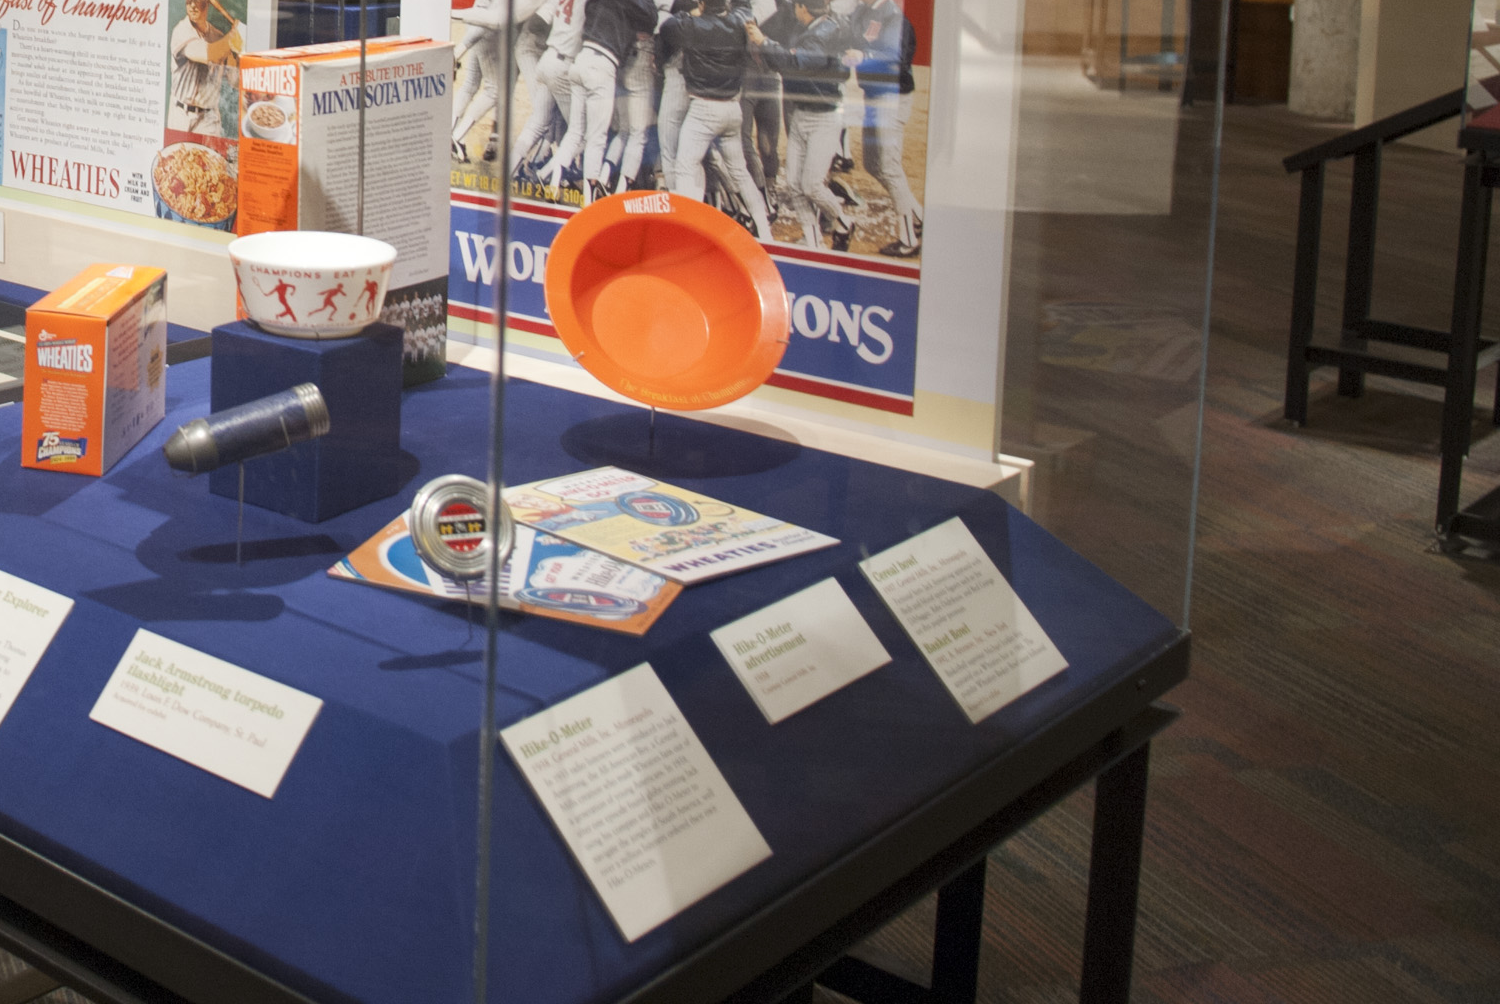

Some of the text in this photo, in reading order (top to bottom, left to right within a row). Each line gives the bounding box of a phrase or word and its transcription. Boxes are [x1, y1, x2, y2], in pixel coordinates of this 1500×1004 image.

[242, 64, 296, 96] WHEATIES
[339, 62, 424, 86] A TRBUTE TO THE
[402, 74, 446, 102] TWINS
[10, 150, 120, 199] WHEATIES
[451, 171, 460, 185] ET
[463, 173, 477, 187] WT
[522, 182, 532, 195] LB
[535, 184, 542, 197] 2
[125, 186, 149, 197] CREAM AND
[623, 193, 669, 214] WHEATIES
[250, 266, 321, 279] CHAMPIONS
[334, 270, 355, 279] EAT
[37, 344, 93, 373] WHEATIES
[641, 388, 688, 403] Breakfast
[38, 446, 81, 459] CHAMPIONS
[42, 432, 60, 447] 75
[663, 542, 777, 572] WHEATIES
[871, 553, 919, 583] Cereal bowl
[0, 590, 51, 620] Explorer
[731, 618, 795, 656] Hike-O-Meter
[742, 631, 807, 670] advertisement
[922, 622, 972, 654] Basket Bowl
[124, 662, 187, 699] flashlight
[133, 648, 287, 723] Jack Armstrong torpedo
[518, 712, 596, 760] Hike-O-Meter
